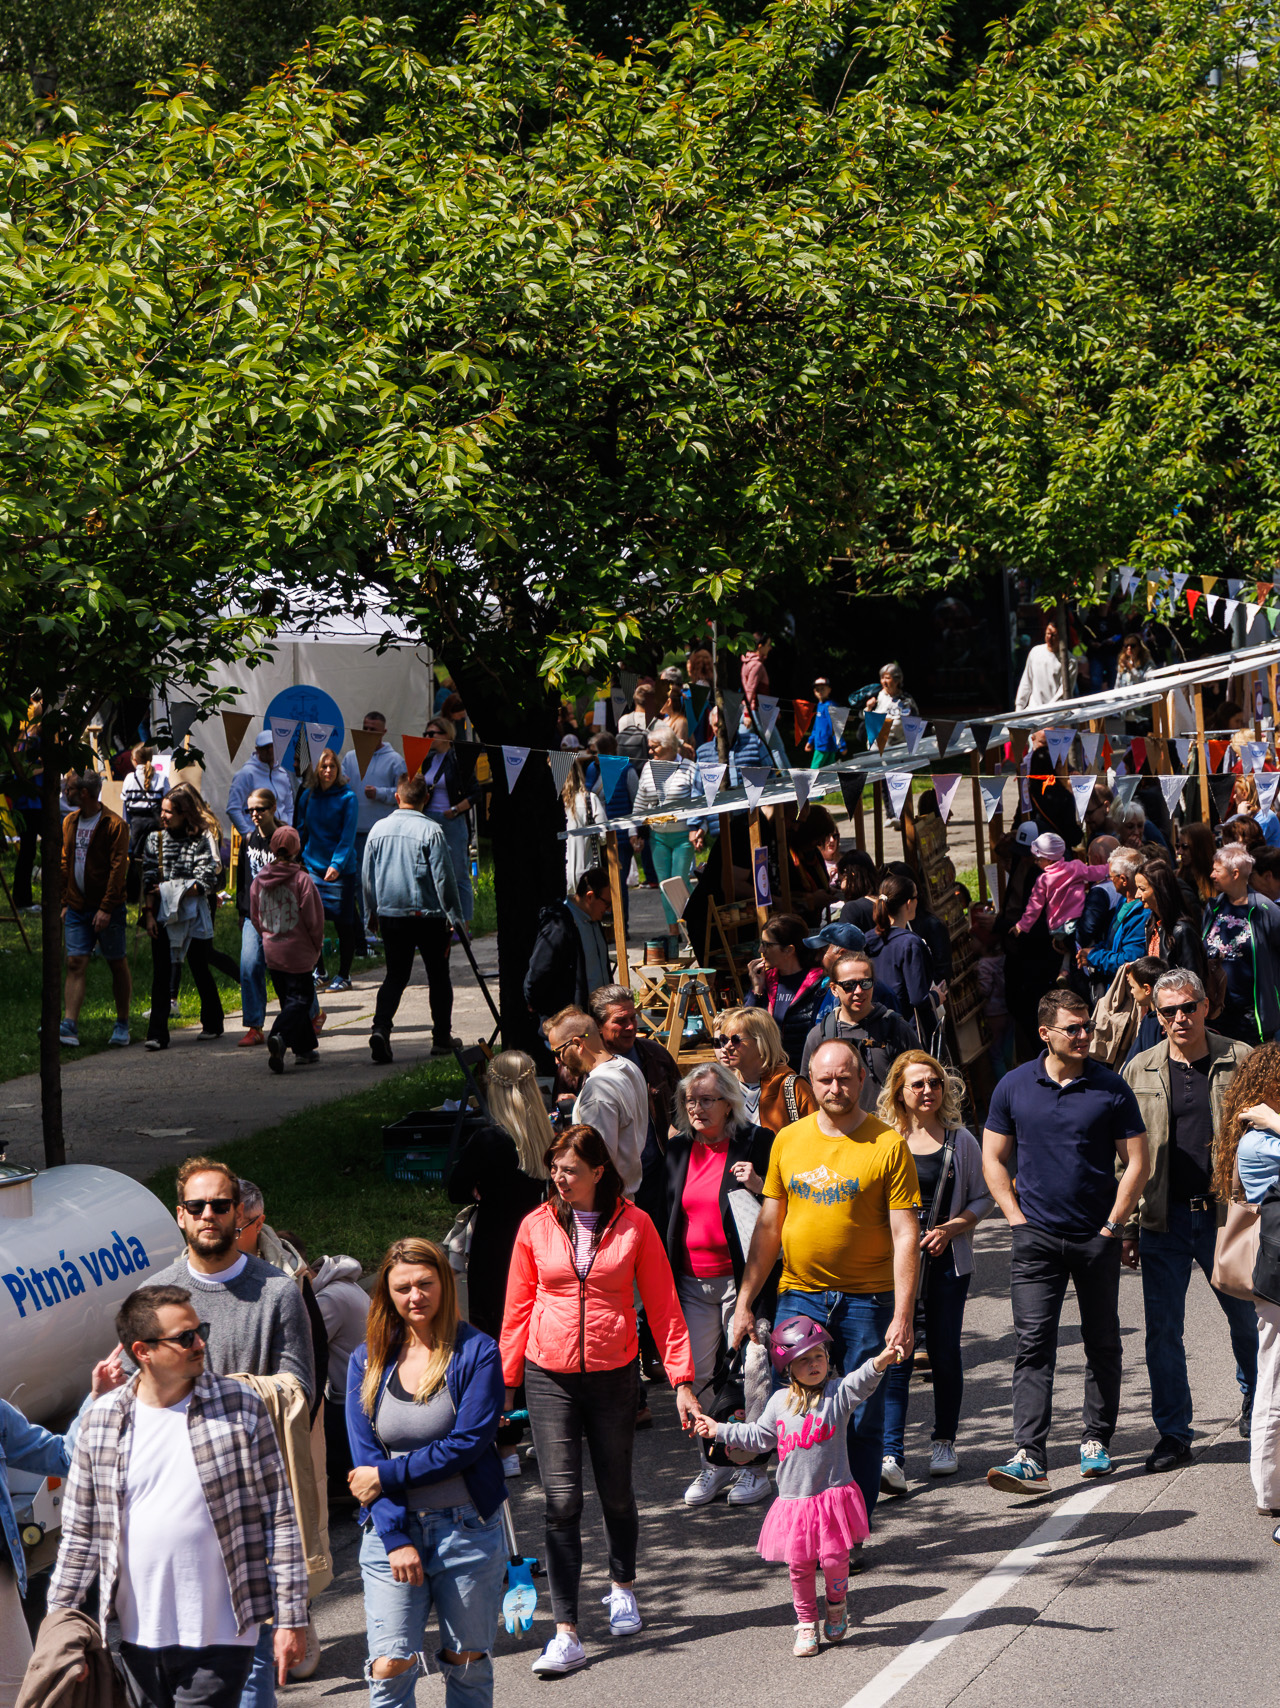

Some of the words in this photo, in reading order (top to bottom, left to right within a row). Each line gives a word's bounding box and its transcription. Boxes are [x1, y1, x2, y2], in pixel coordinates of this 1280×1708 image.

[1, 1249, 86, 1318] Pitná
[79, 1230, 150, 1287] voda
[776, 1413, 836, 1461] Barbie
